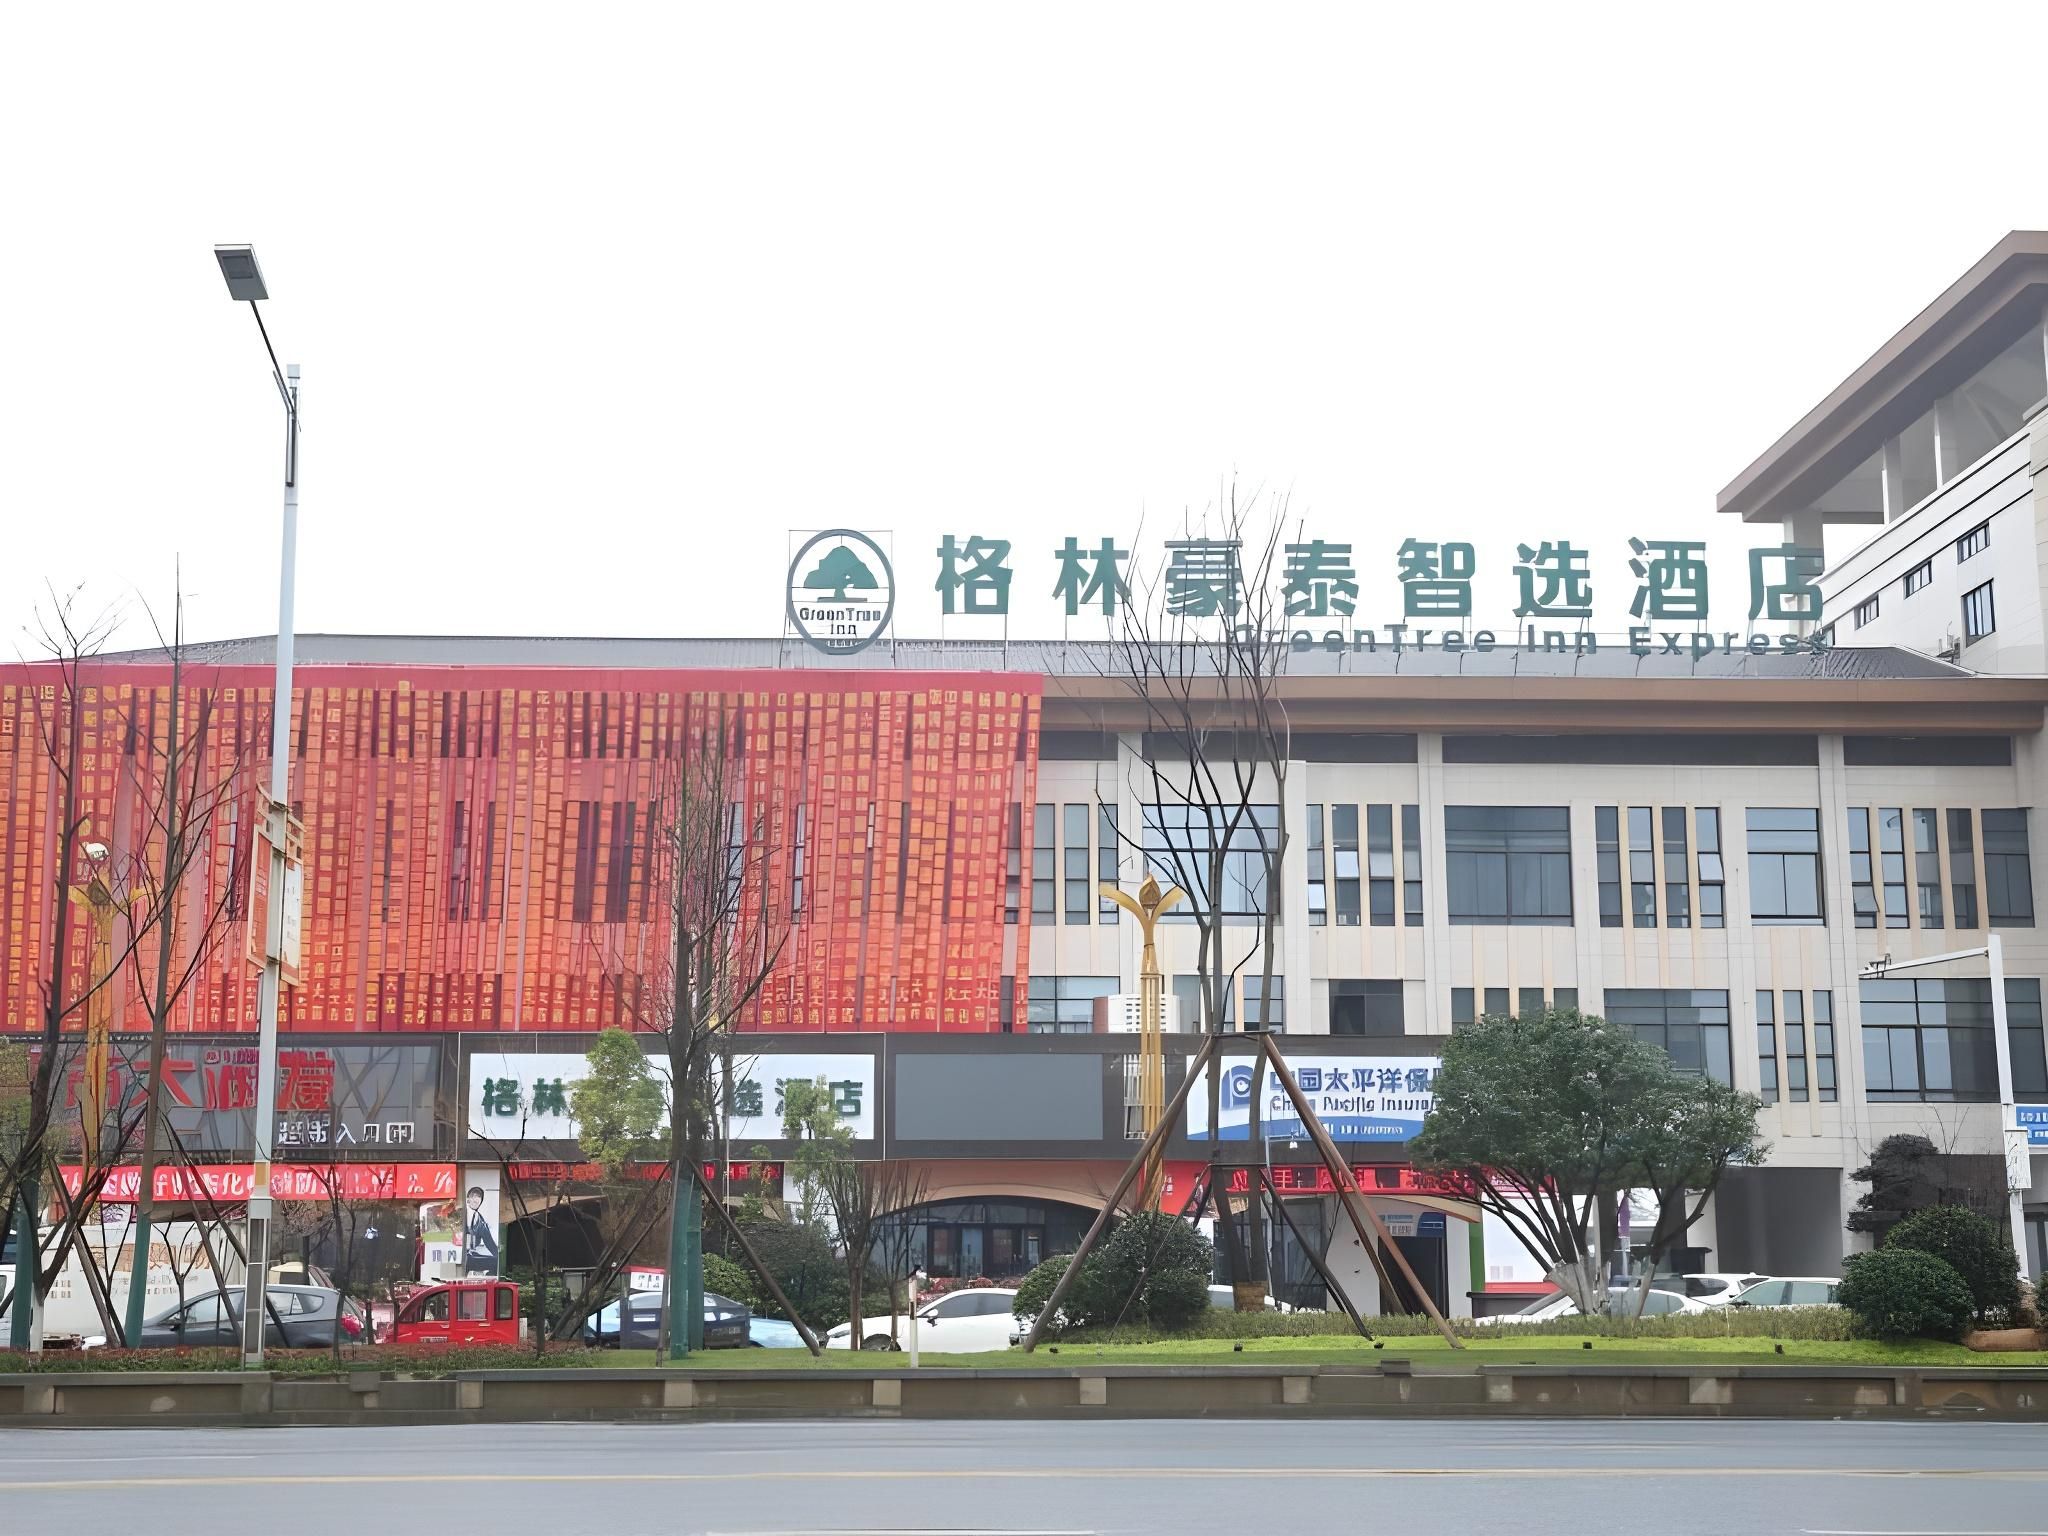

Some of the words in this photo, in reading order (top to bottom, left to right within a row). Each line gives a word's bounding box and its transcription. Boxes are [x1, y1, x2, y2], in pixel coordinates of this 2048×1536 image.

[934, 534, 1825, 621] 格林豪泰智选酒店
[1527, 624, 1597, 654] Inn
[1269, 1067, 1443, 1093] 中国太平洋保
